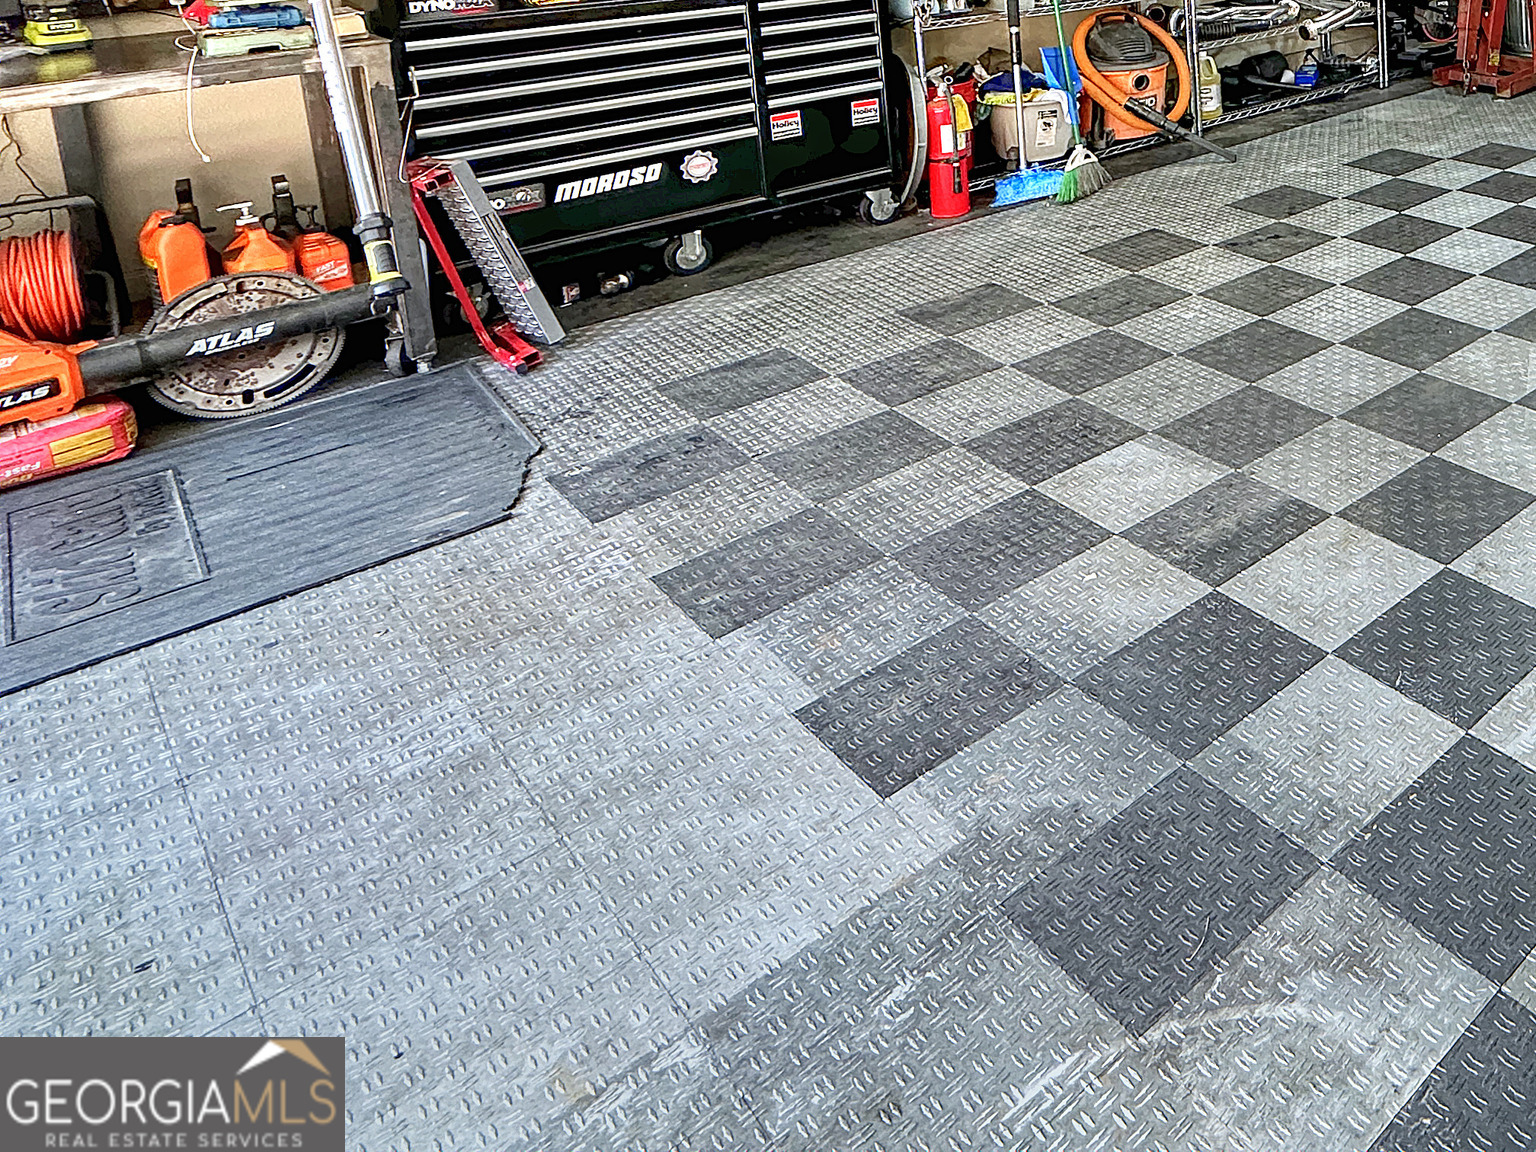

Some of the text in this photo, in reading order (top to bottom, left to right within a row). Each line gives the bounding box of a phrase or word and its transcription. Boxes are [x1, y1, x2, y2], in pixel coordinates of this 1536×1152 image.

[853, 107, 878, 116] Holley
[772, 120, 799, 130] Holley
[554, 162, 663, 203] MOROSO
[185, 321, 276, 357] ATLAS
